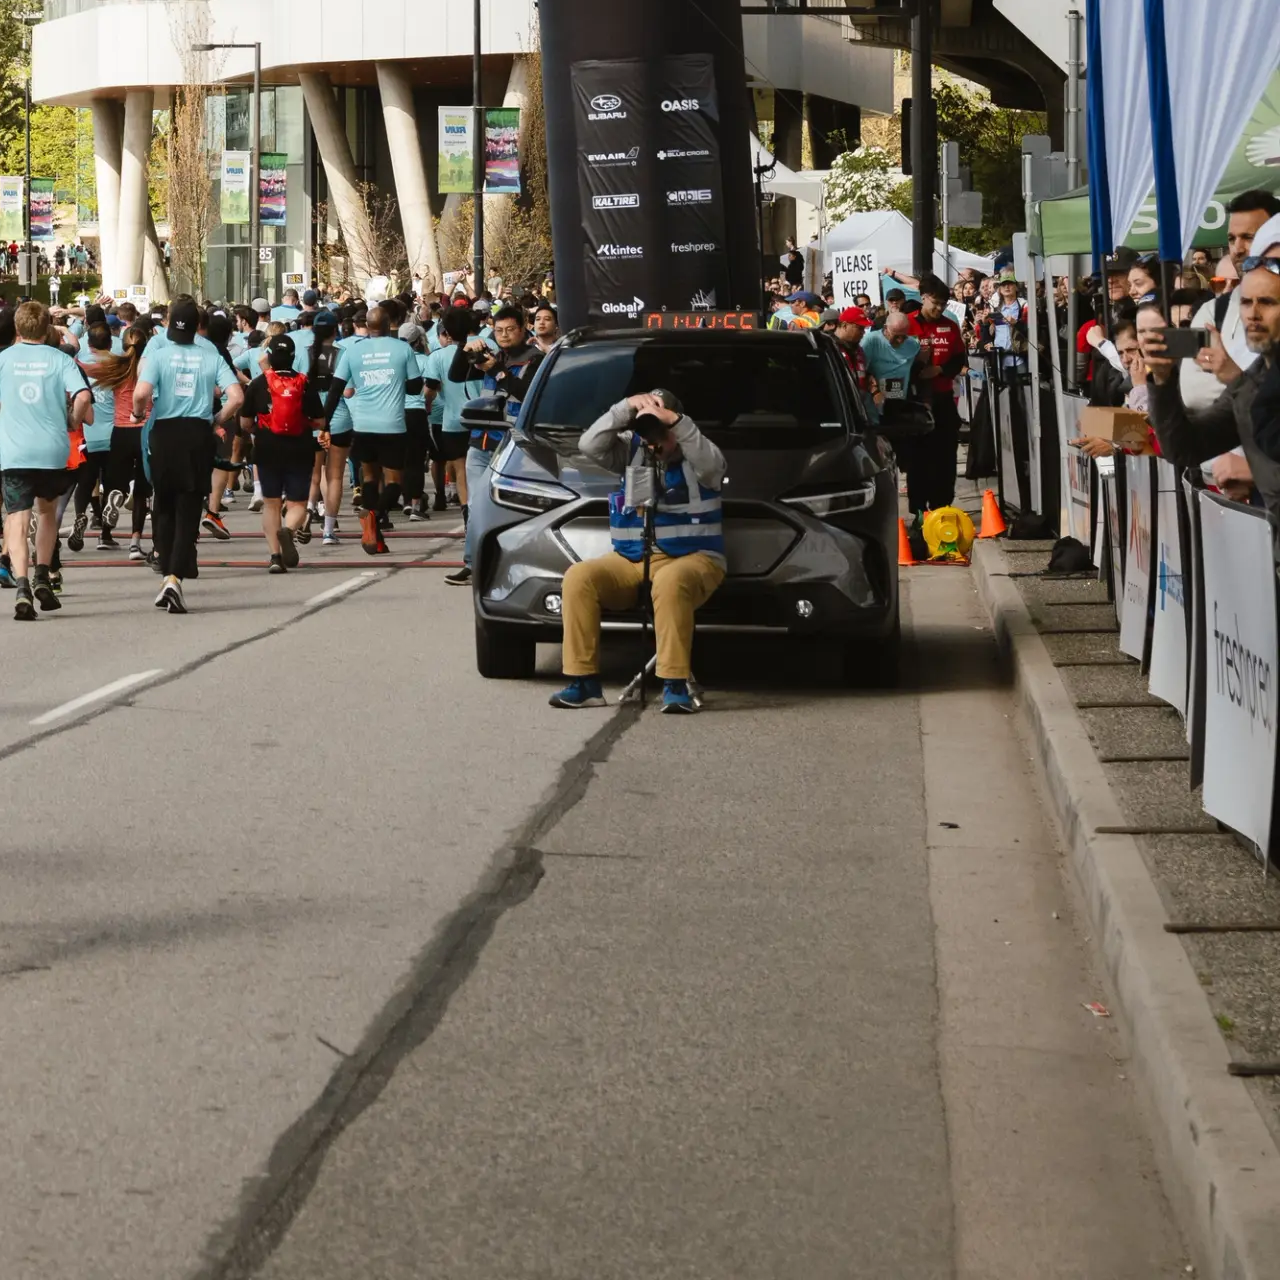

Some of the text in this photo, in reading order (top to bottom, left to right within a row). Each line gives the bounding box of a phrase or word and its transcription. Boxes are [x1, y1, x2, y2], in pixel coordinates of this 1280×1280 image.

[661, 99, 700, 112] OASIS
[588, 111, 627, 121] SUBARU
[610, 244, 644, 256] kintec
[670, 242, 716, 253] freshprep
[835, 253, 873, 274] PLEASE
[843, 279, 869, 298] KEEP
[602, 301, 638, 314] Global
